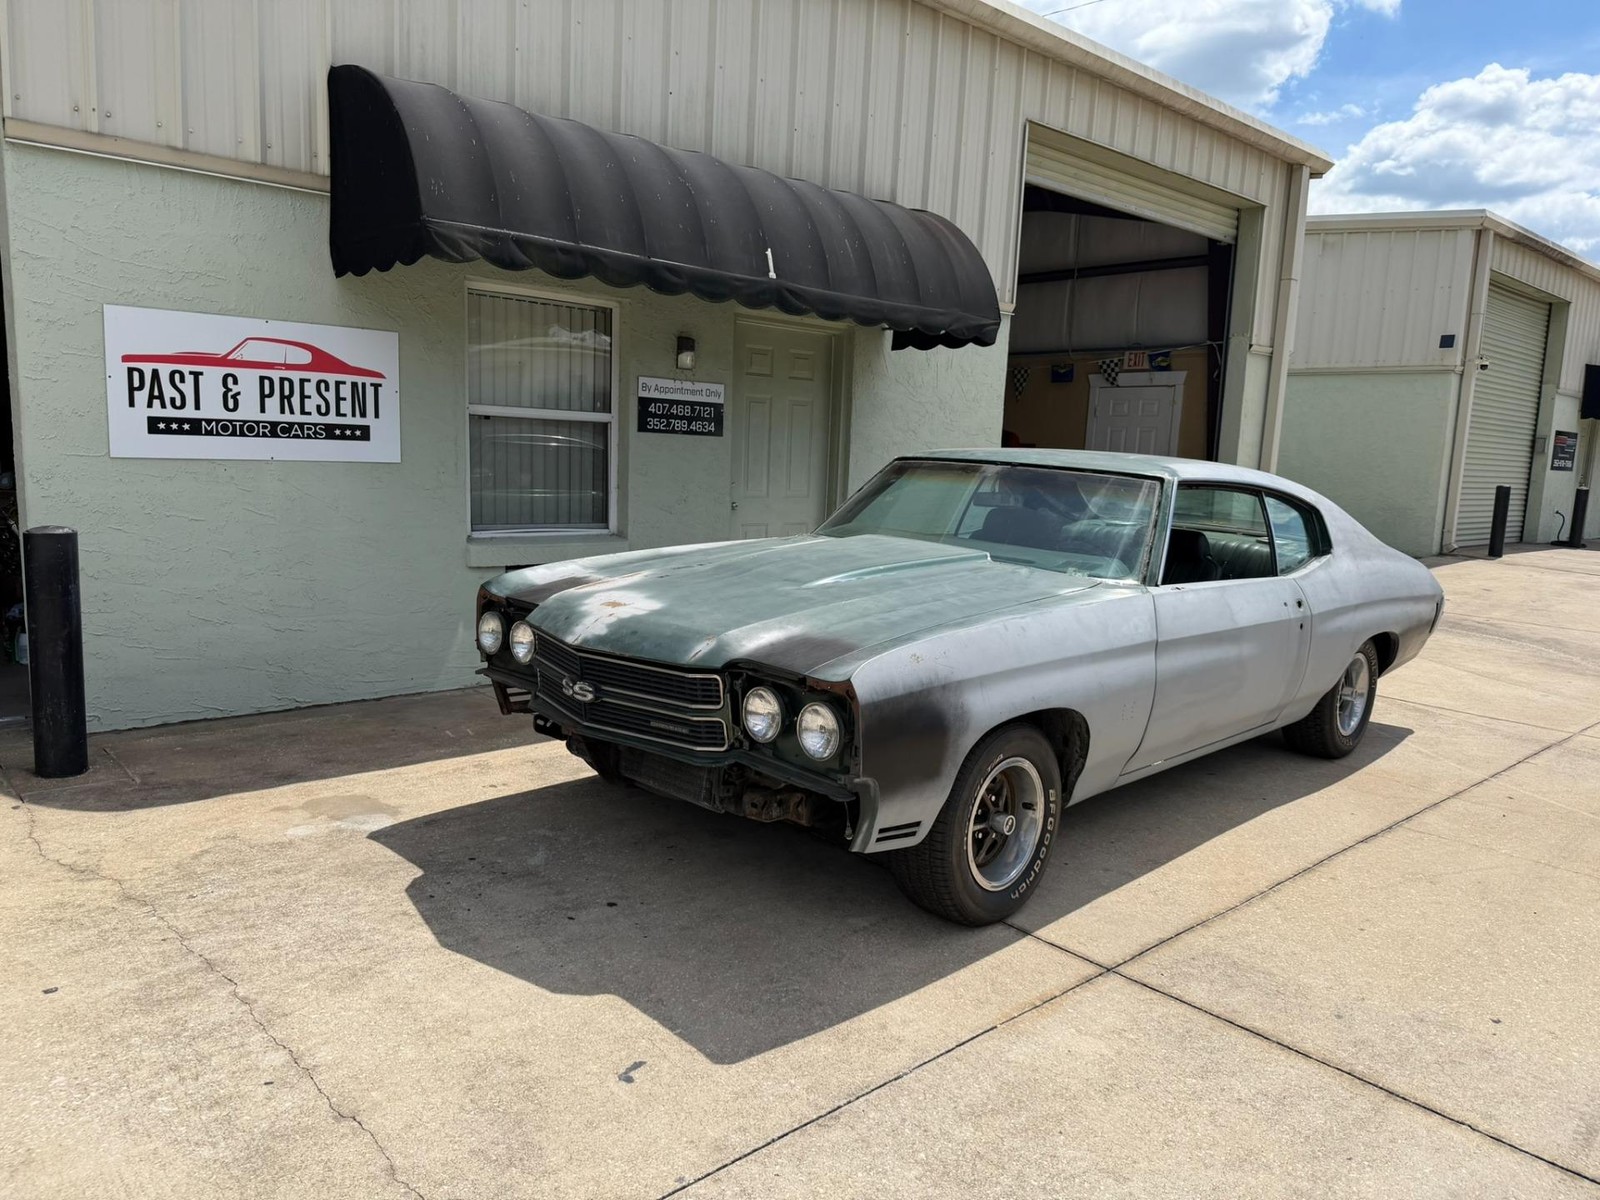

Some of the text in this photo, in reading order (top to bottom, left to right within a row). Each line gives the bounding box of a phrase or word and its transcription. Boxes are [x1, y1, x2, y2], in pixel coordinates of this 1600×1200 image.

[1128, 352, 1146, 367] EXIT
[127, 366, 383, 419] PAST & PRESENT
[641, 382, 722, 399] By Appointment Only
[648, 403, 714, 418] 407.468.7121
[201, 420, 326, 439] MOTOR CARS
[647, 418, 715, 433] 352.789.4634
[562, 679, 594, 701] SS
